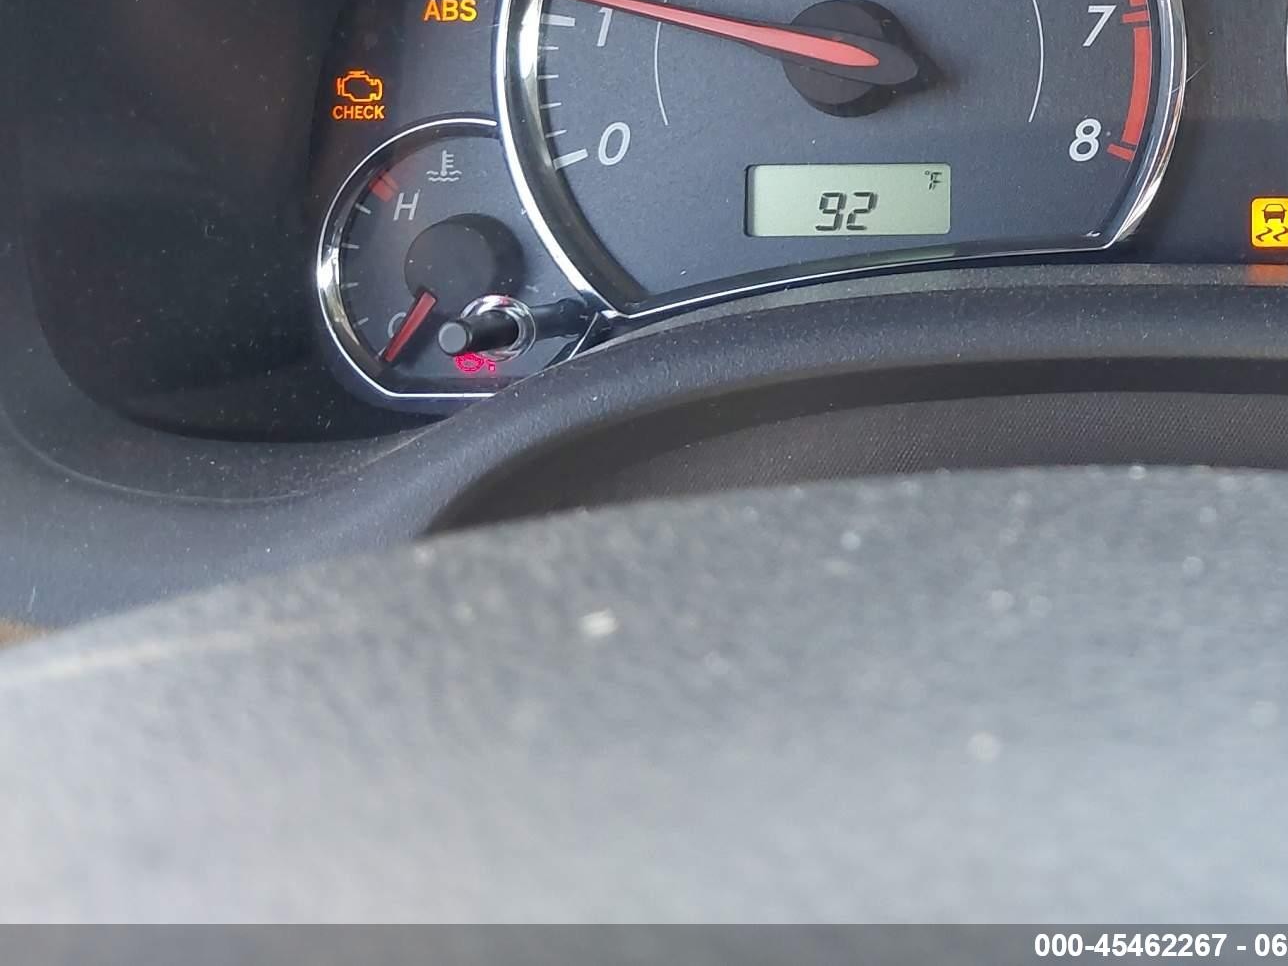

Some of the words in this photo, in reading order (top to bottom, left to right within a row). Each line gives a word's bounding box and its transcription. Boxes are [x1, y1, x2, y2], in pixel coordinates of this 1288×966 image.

[597, 7, 614, 47] 1
[1082, 5, 1116, 47] 7
[333, 105, 385, 120] CHECK
[598, 122, 631, 165] 0
[1068, 120, 1102, 162] 8
[393, 193, 420, 220] H
[816, 192, 878, 231] 92
